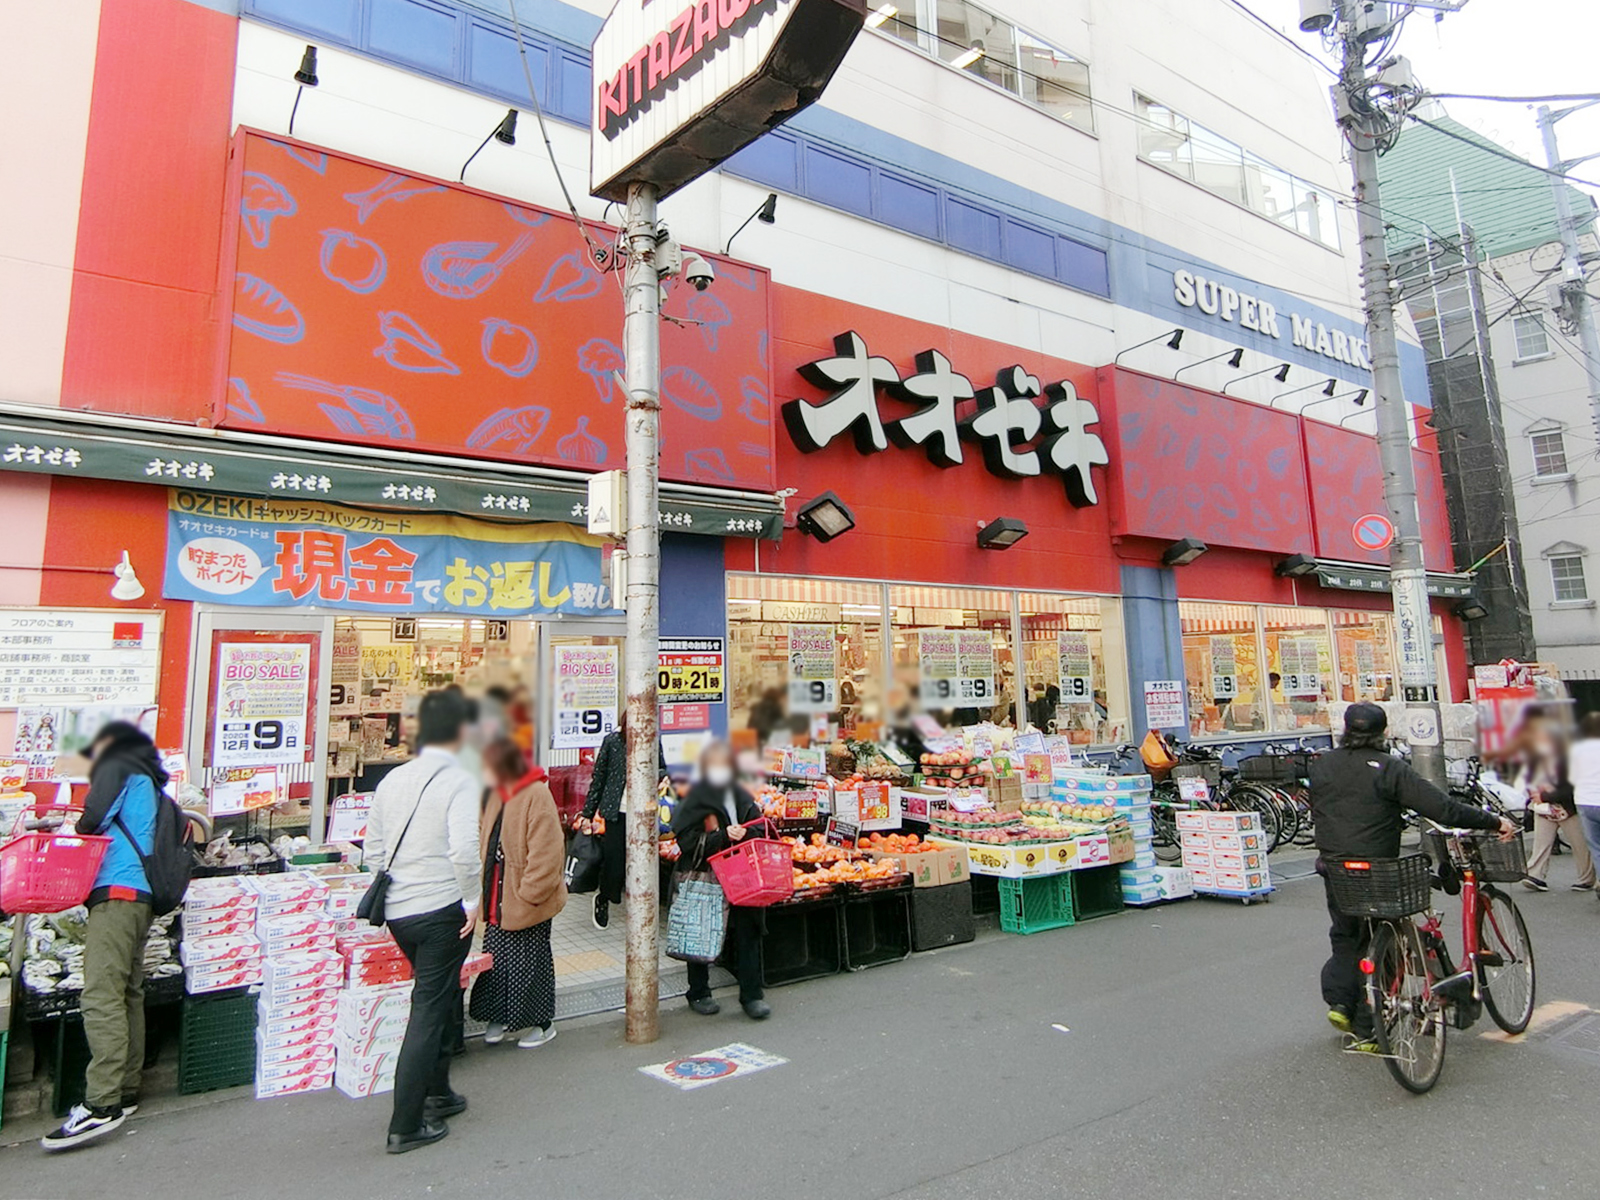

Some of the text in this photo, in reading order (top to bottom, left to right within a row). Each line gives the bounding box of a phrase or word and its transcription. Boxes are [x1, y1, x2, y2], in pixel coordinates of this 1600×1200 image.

[1173, 268, 1281, 340] SUPER
[784, 330, 1109, 508] オオゼキ
[3, 443, 82, 468] オオゼキ
[145, 458, 214, 481] オオゼキ
[270, 472, 332, 493] オオゼキ
[381, 482, 437, 503] オオゼキ
[481, 493, 530, 512] オオゼキ
[178, 519, 270, 540] オオゼキカードは
[726, 518, 763, 533] オオゼキ
[187, 546, 248, 569] 貯まった
[196, 566, 254, 586] ポイント
[772, 604, 829, 621] CASHIER
[11, 619, 74, 628] フロアのご案内
[396, 622, 415, 636] 11
[2, 636, 53, 644] 本部事務所
[791, 639, 808, 651] BIG
[226, 664, 254, 679] BIG
[561, 663, 580, 675] BIG
[222, 740, 249, 751] 12月
[875, 805, 888, 819] 98
